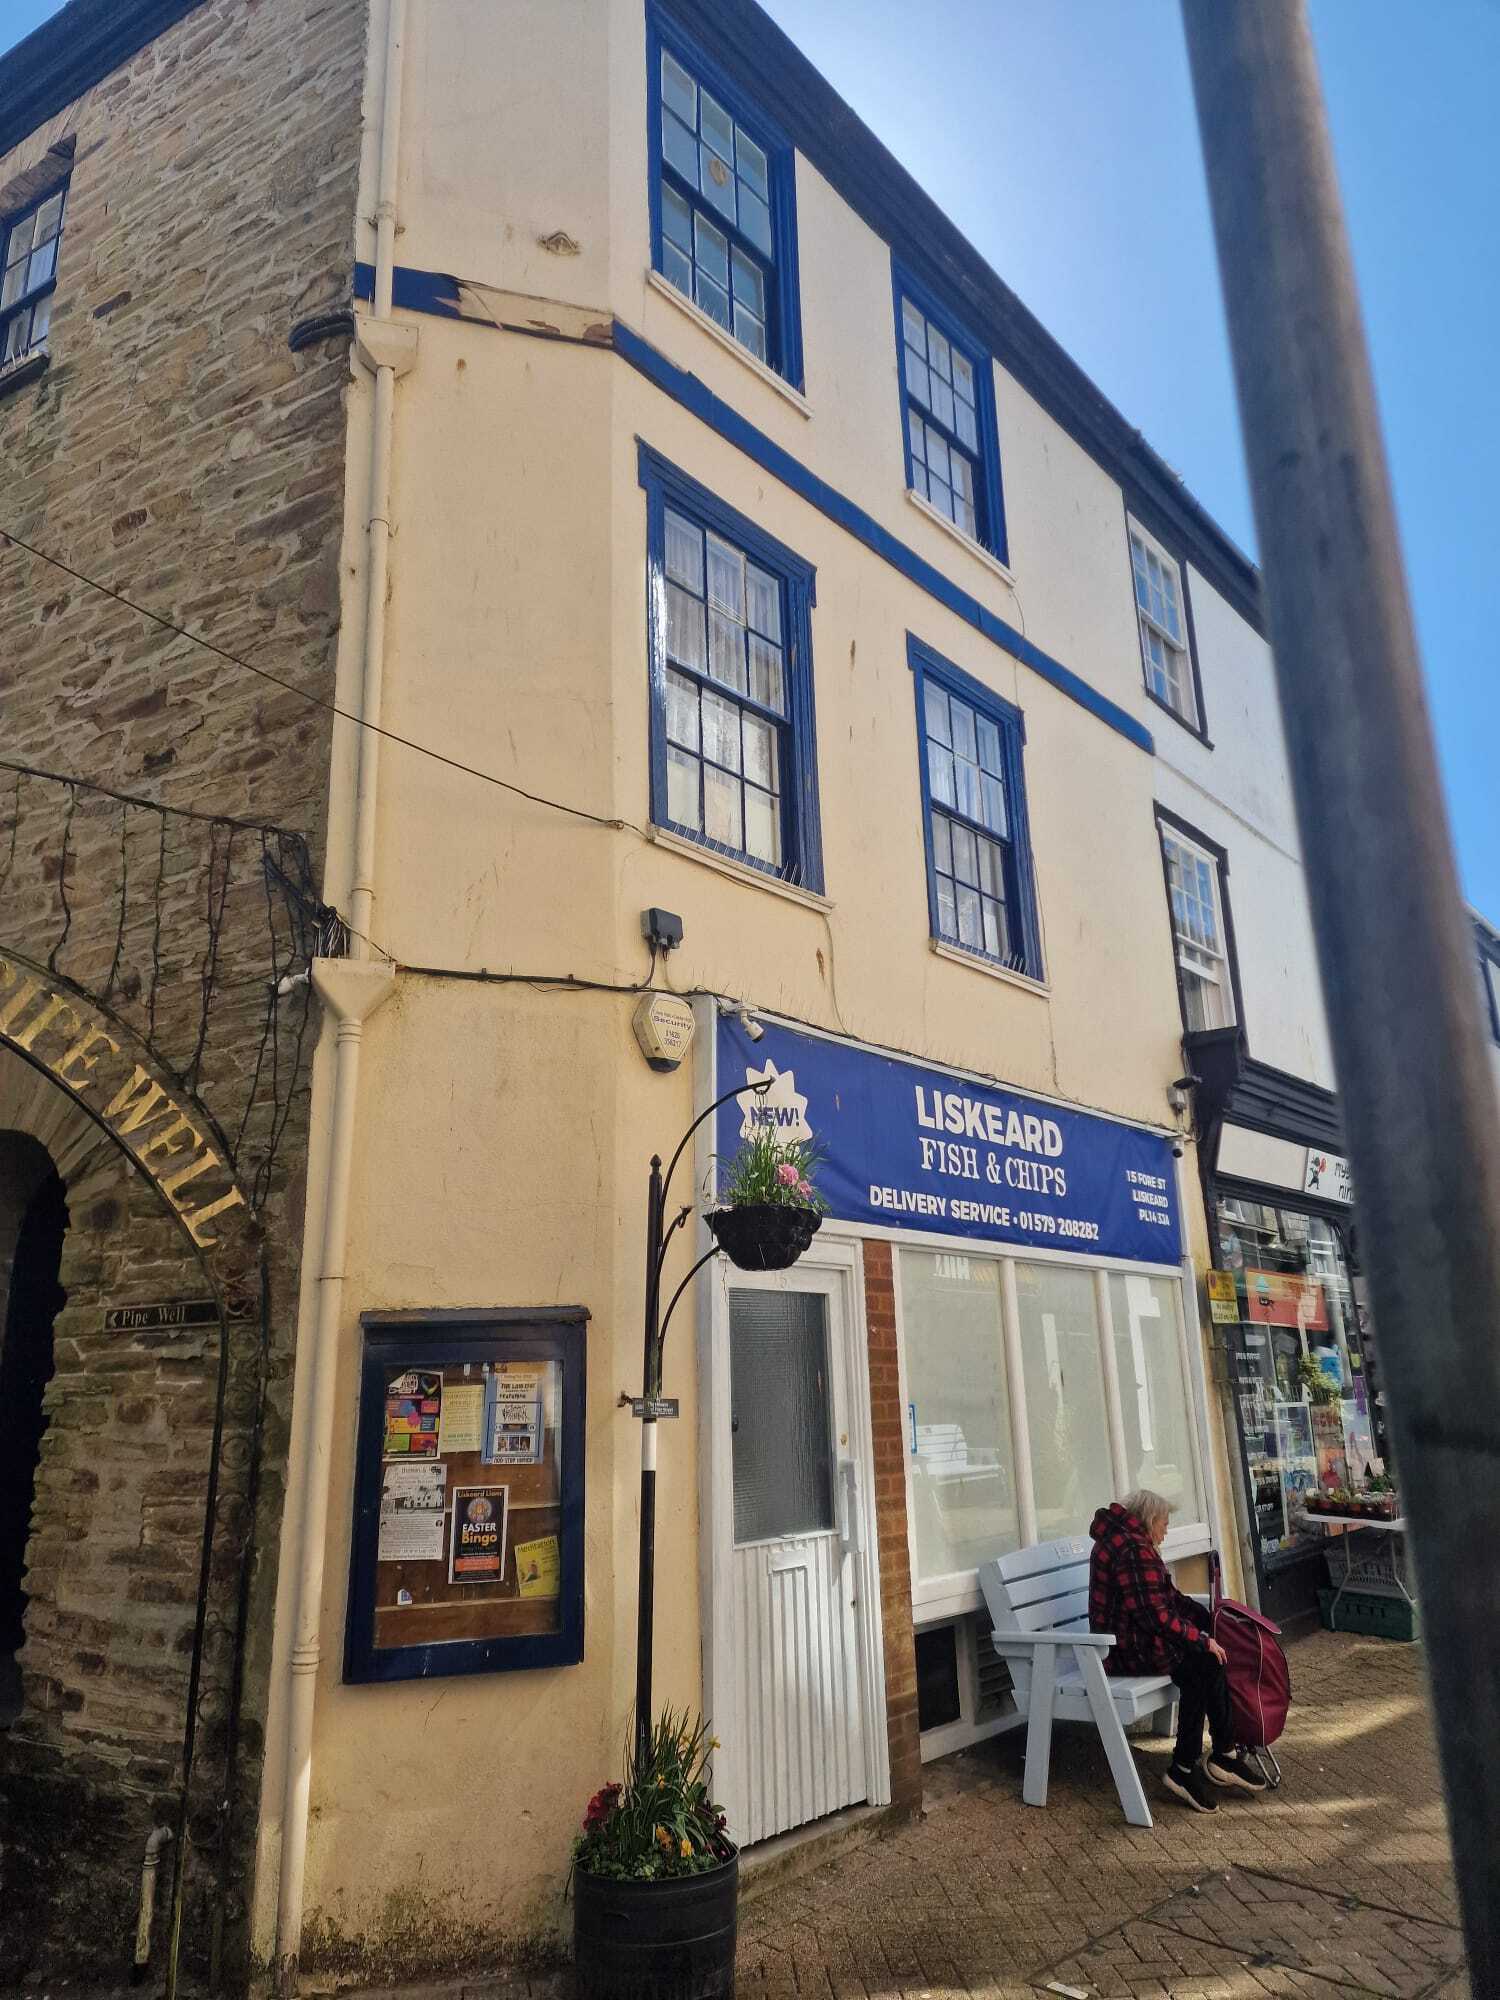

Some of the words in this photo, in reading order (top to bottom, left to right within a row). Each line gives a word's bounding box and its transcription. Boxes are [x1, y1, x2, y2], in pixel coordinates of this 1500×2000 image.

[750, 1106, 800, 1127] NEW!
[915, 1085, 1063, 1157] LISKEARD
[102, 1063, 247, 1248] WELL
[919, 1137, 980, 1180] FISH
[986, 1152, 1002, 1185] &
[1005, 1156, 1067, 1197] CHIPS
[1126, 1169, 1137, 1184] 15
[1138, 1172, 1157, 1189] FORE
[1157, 1177, 1167, 1191] ST
[1132, 1189, 1169, 1209] LISKEARD
[869, 1185, 947, 1217] DELIVERY
[951, 1199, 1011, 1227] SERVICE
[1019, 1211, 1056, 1234] 01579
[1058, 1218, 1099, 1240] 208282
[1139, 1208, 1157, 1224] PL14
[121, 1310, 149, 1329] Pipe
[158, 1305, 186, 1323] Well
[462, 1522, 497, 1532] EASTER
[461, 1531, 498, 1547] Bingo
